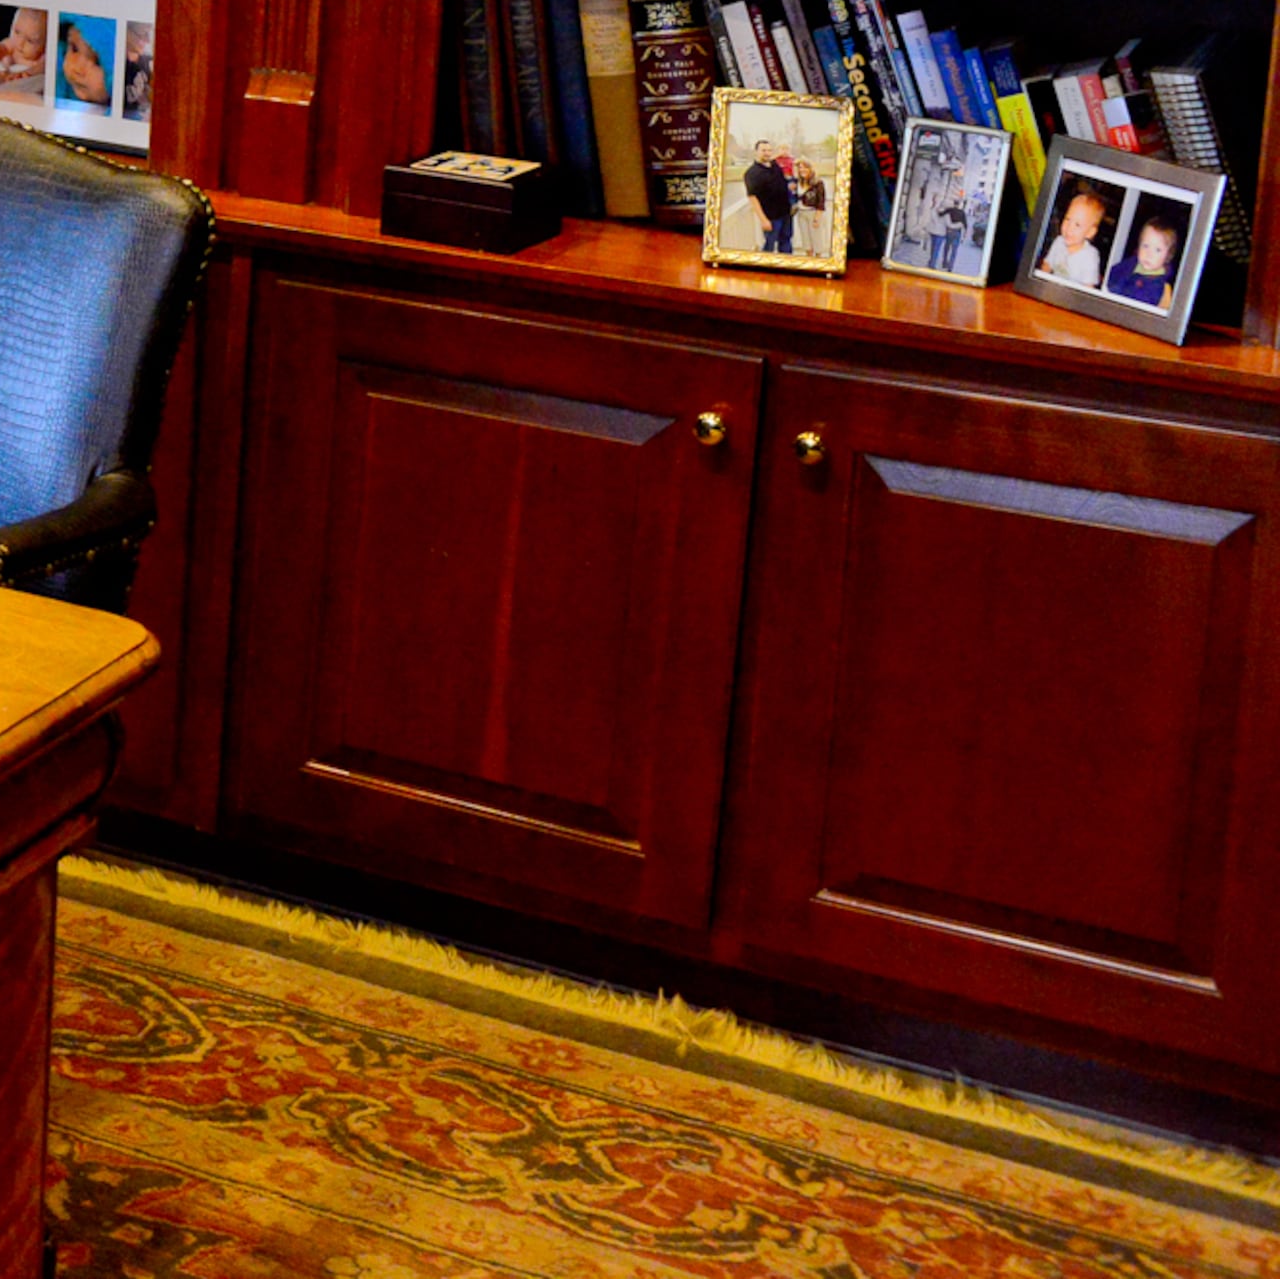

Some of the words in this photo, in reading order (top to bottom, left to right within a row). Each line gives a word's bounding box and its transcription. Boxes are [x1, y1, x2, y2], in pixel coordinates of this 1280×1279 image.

[717, 35, 737, 68] Creative
[744, 43, 761, 69] THE
[654, 61, 670, 69] THE
[674, 60, 695, 68] YALE
[646, 68, 705, 80] SHAKESPEARE
[842, 52, 889, 142] Second
[872, 135, 896, 177] City
[662, 126, 701, 136] COMPLETE
[671, 134, 698, 142] WORKS
